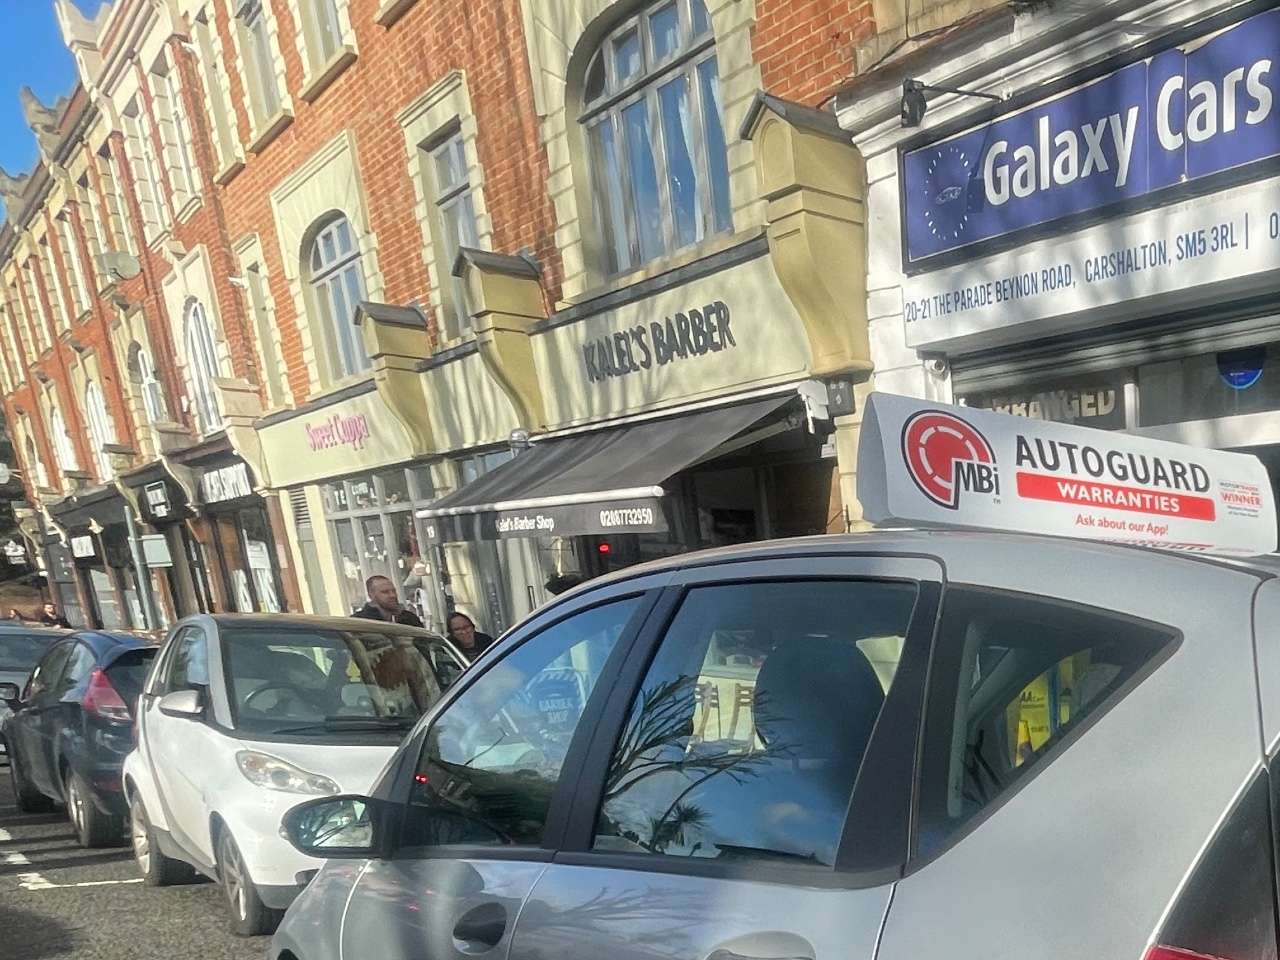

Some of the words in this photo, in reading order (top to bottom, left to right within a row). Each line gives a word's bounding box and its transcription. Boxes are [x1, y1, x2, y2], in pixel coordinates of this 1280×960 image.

[983, 104, 1141, 206] Galaxy
[1157, 58, 1274, 153] Cars
[905, 298, 932, 323] 20-21
[933, 292, 952, 315] THE
[953, 283, 993, 312] PARADE
[996, 272, 1038, 302] BEYNON
[1042, 264, 1076, 291] ROAD,
[1085, 240, 1172, 283] CARSHALTON,
[1176, 230, 1207, 261] SM5
[1211, 222, 1238, 252] 3RL
[583, 324, 651, 384] KALEL'S
[650, 300, 737, 366] BARBER
[1016, 435, 1211, 493] AUTOGUARD
[537, 515, 555, 533] Shop
[1057, 481, 1181, 513] WARRANTIES
[1075, 513, 1094, 526] Ask
[1097, 516, 1126, 531] about
[1129, 521, 1145, 532] our
